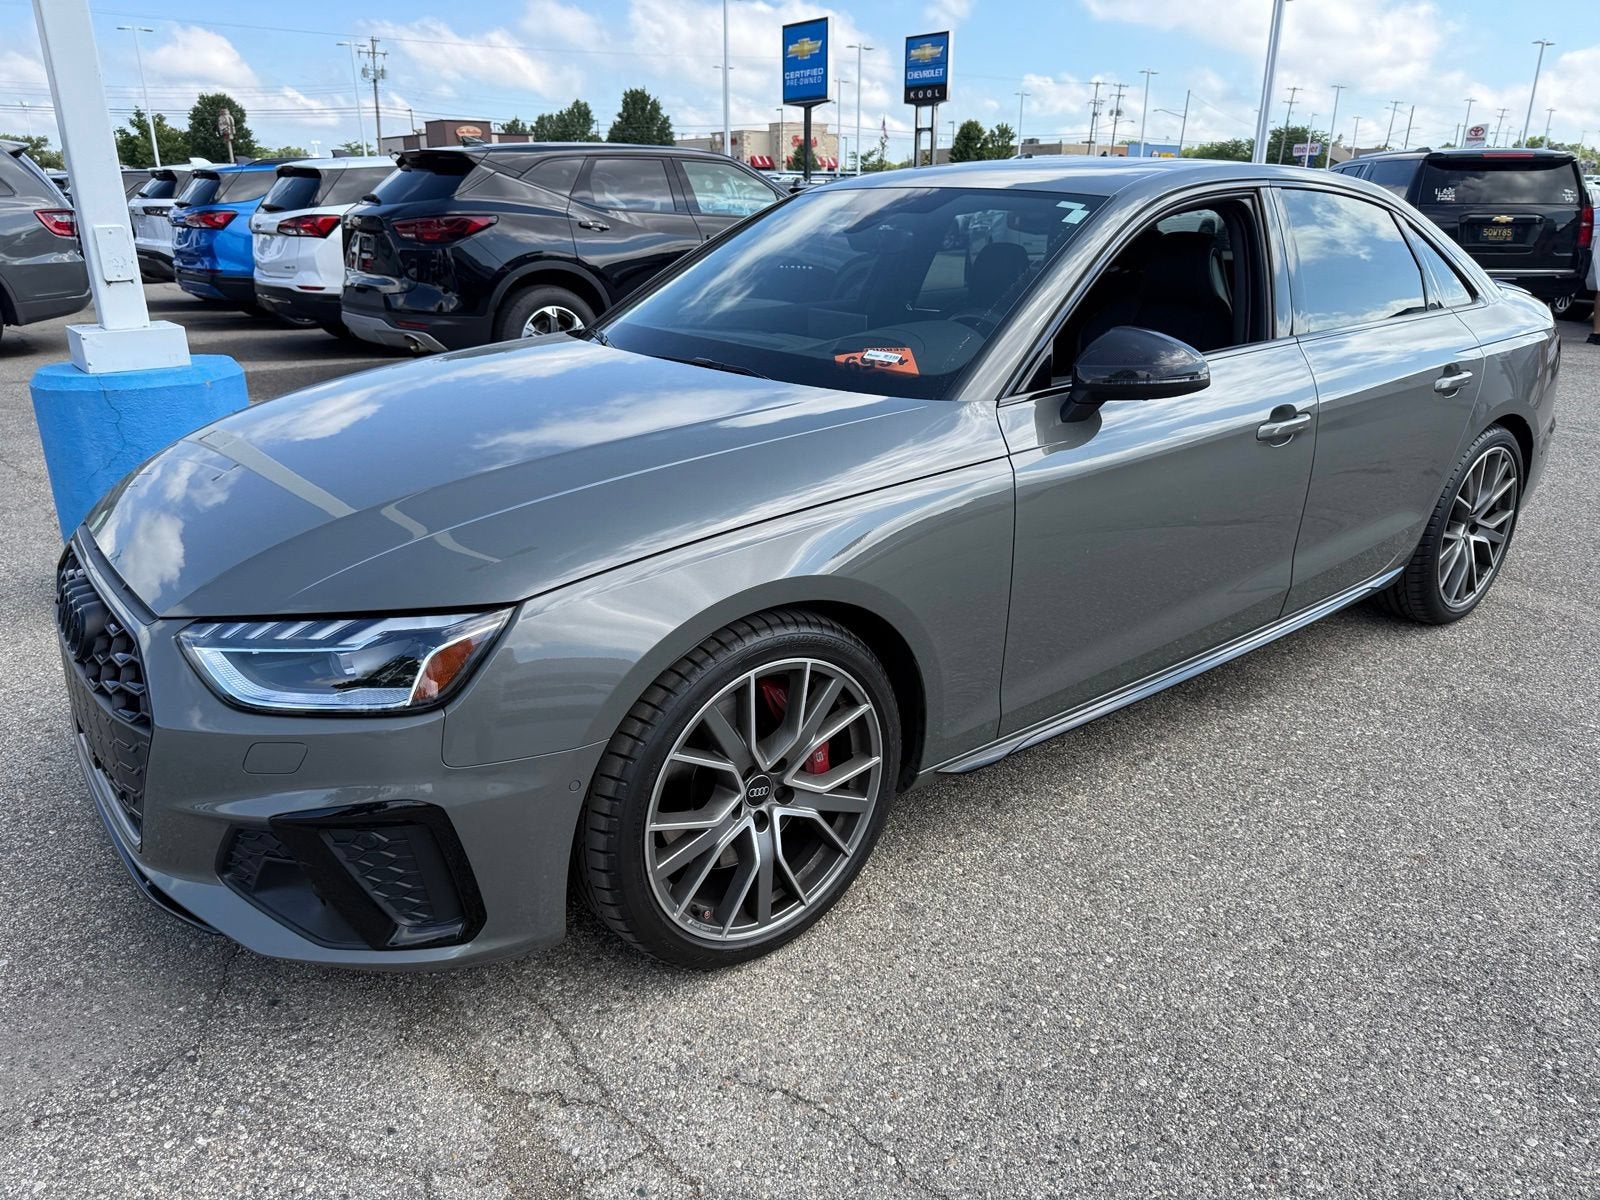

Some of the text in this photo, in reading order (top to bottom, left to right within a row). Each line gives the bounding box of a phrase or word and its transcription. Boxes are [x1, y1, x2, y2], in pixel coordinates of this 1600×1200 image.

[785, 67, 824, 80] CERTIFIED
[907, 68, 944, 80] CHEVROLET
[786, 75, 822, 86] PRE-OWNED
[910, 89, 940, 99] KOOL
[1294, 146, 1318, 154] meer
